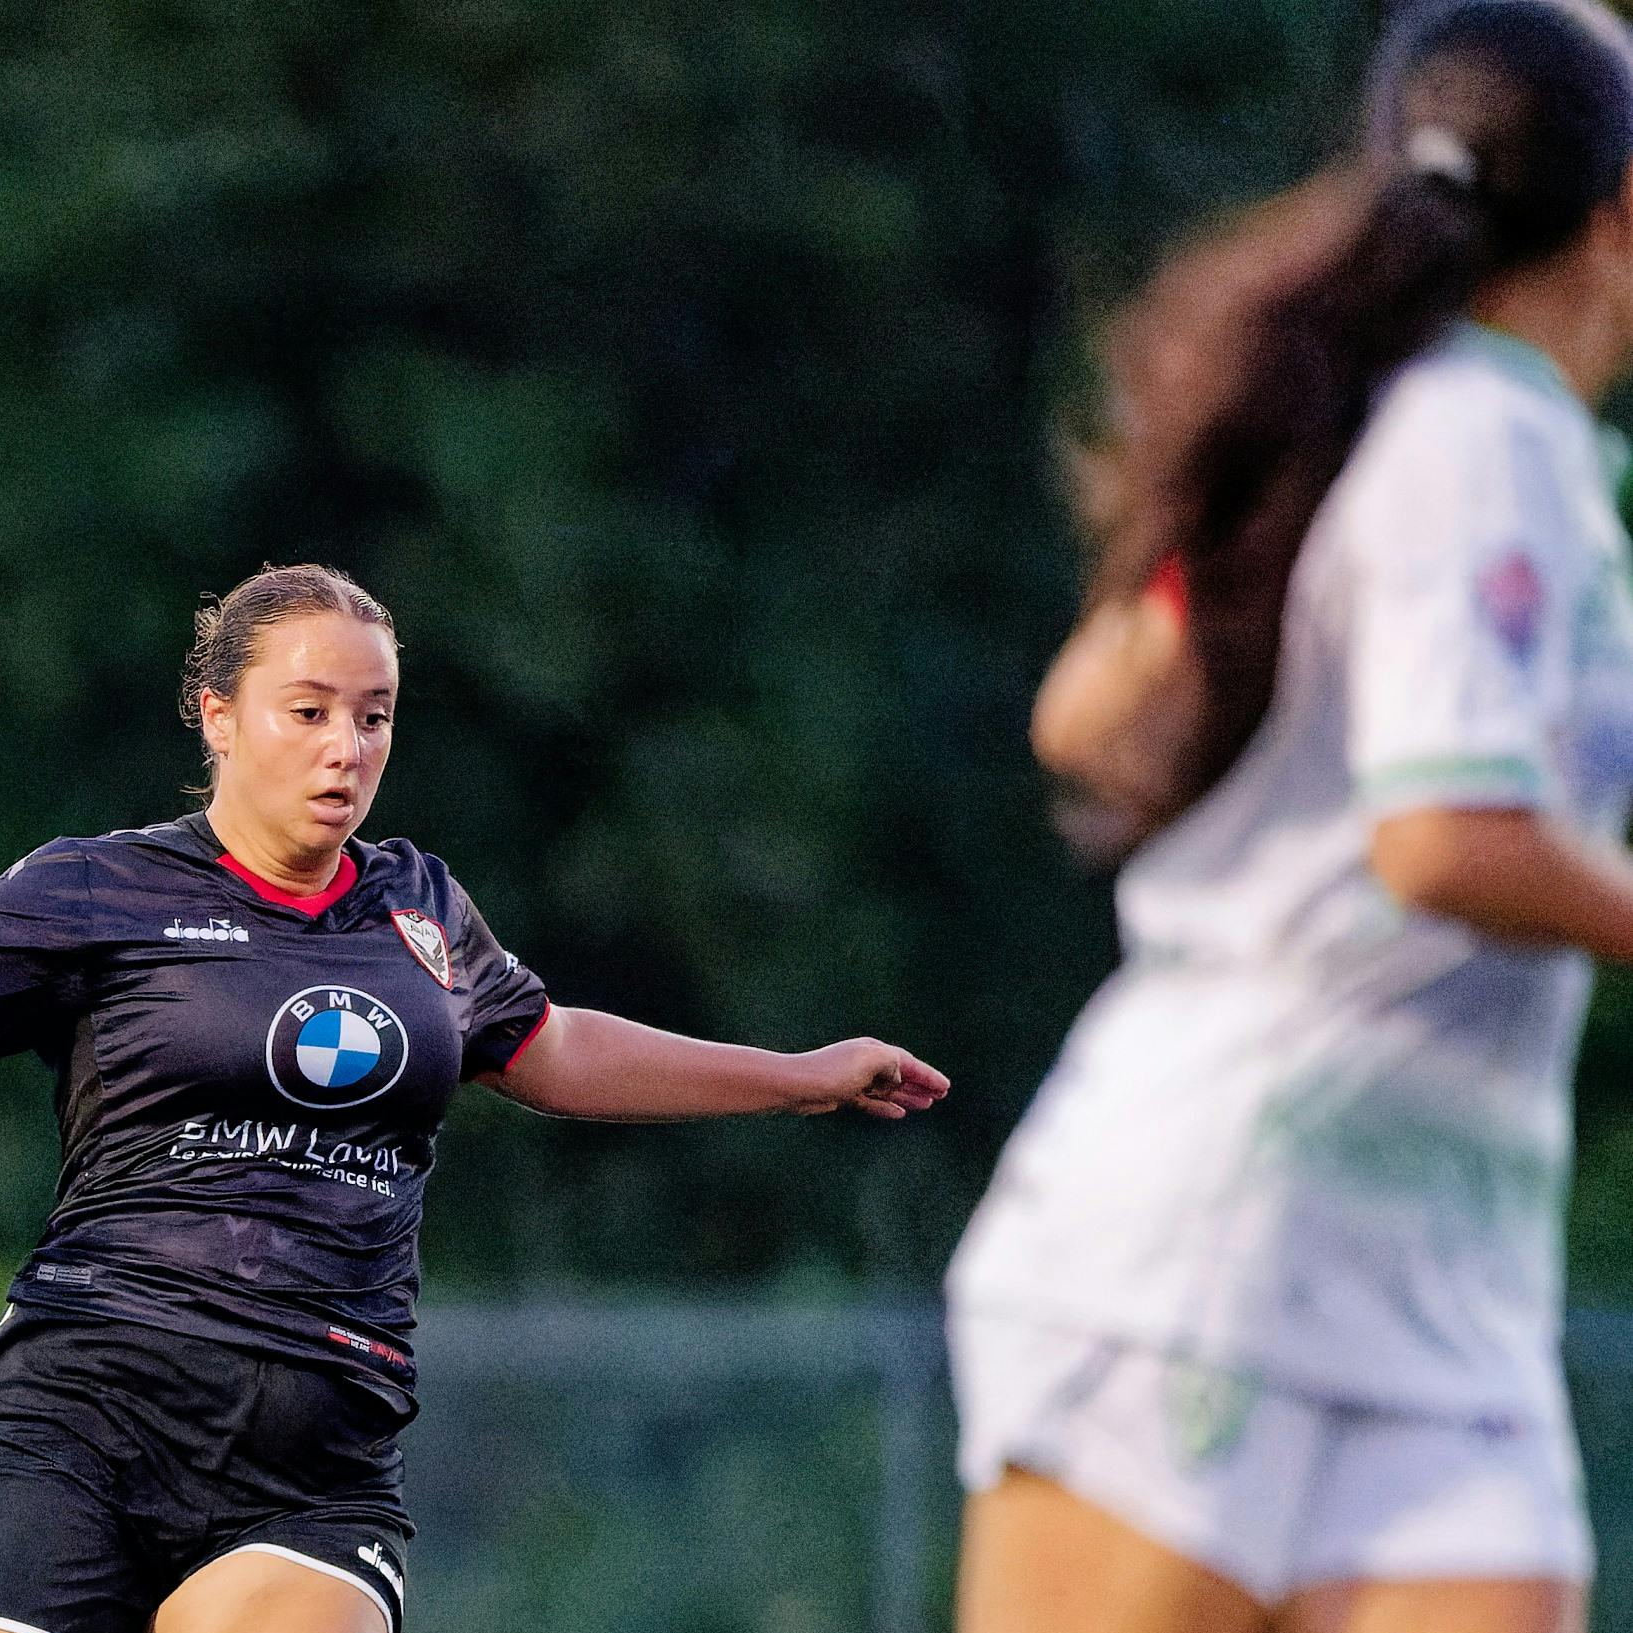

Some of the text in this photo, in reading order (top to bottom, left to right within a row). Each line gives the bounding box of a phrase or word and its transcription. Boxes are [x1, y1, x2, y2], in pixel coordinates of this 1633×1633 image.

[163, 918, 249, 943] diadora
[289, 990, 395, 1030] BMW
[371, 1175, 396, 1199] ici.
